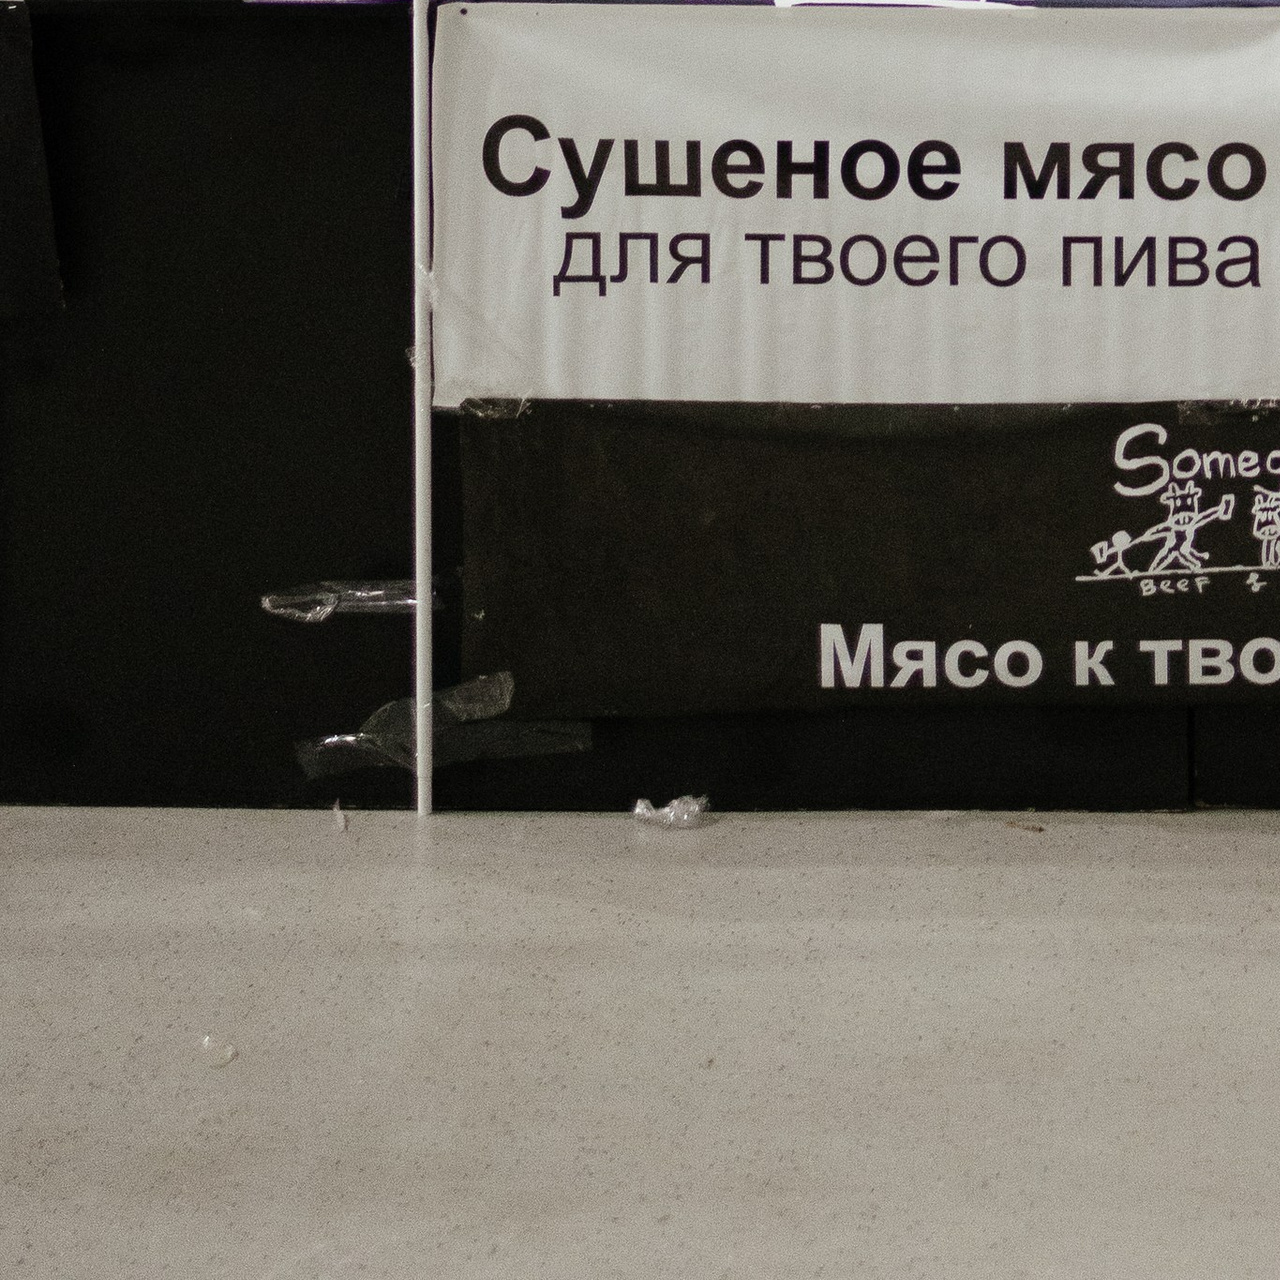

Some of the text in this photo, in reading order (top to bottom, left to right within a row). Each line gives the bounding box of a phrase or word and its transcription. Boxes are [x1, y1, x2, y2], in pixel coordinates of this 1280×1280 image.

[482, 114, 1267, 220] Сушеное мясо
[552, 231, 1261, 297] для твоего пива
[819, 623, 1044, 688] Мясо
[1074, 640, 1115, 686] к
